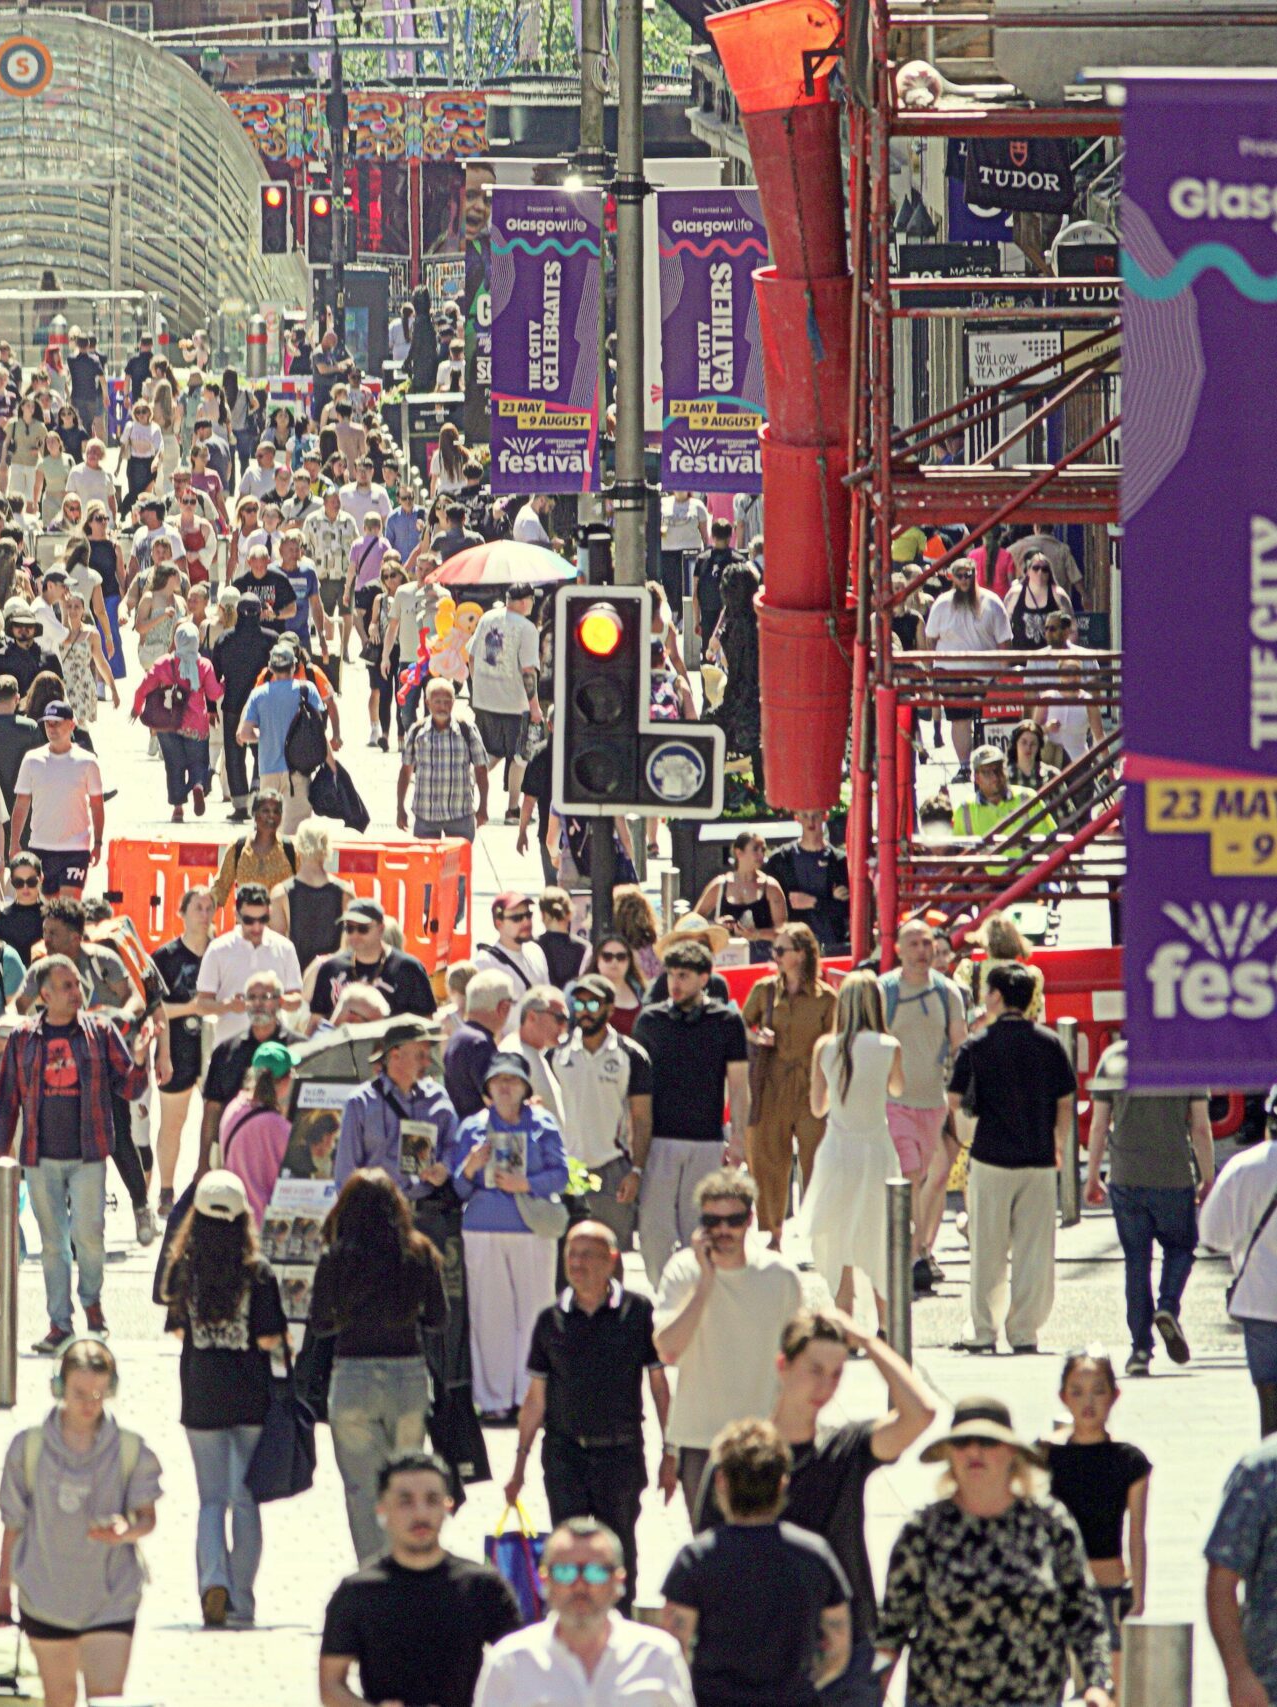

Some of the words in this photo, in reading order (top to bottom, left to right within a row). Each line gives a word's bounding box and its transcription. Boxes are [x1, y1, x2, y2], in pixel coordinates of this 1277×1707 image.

[979, 166, 1060, 191] TUDOR
[1169, 177, 1277, 234] Glas
[1066, 287, 1125, 301] TUDO
[529, 320, 541, 358] CITY
[543, 260, 561, 391] CELEBRATES
[710, 262, 733, 392] GATHERS
[698, 321, 710, 359] CITY
[976, 341, 991, 350] THE
[975, 353, 1018, 366] WILLOW
[976, 366, 996, 379] TEA
[529, 360, 541, 391] THE
[698, 360, 710, 392] THE
[502, 402, 515, 412] 23
[517, 402, 542, 413] MAY
[529, 416, 537, 426] 9
[539, 416, 585, 426] AUGUST
[673, 403, 686, 413] 23
[689, 403, 714, 413] MAY
[701, 416, 709, 426] 9
[711, 416, 757, 427] AUGUST
[498, 449, 592, 473] festival
[669, 449, 763, 474] festival
[1249, 514, 1277, 642] CITY
[1250, 646, 1277, 751] THE
[1159, 788, 1201, 820] 23
[1214, 788, 1277, 820] MA
[1253, 833, 1276, 866] 9
[66, 867, 85, 881] TH
[1146, 941, 1277, 1020] fes
